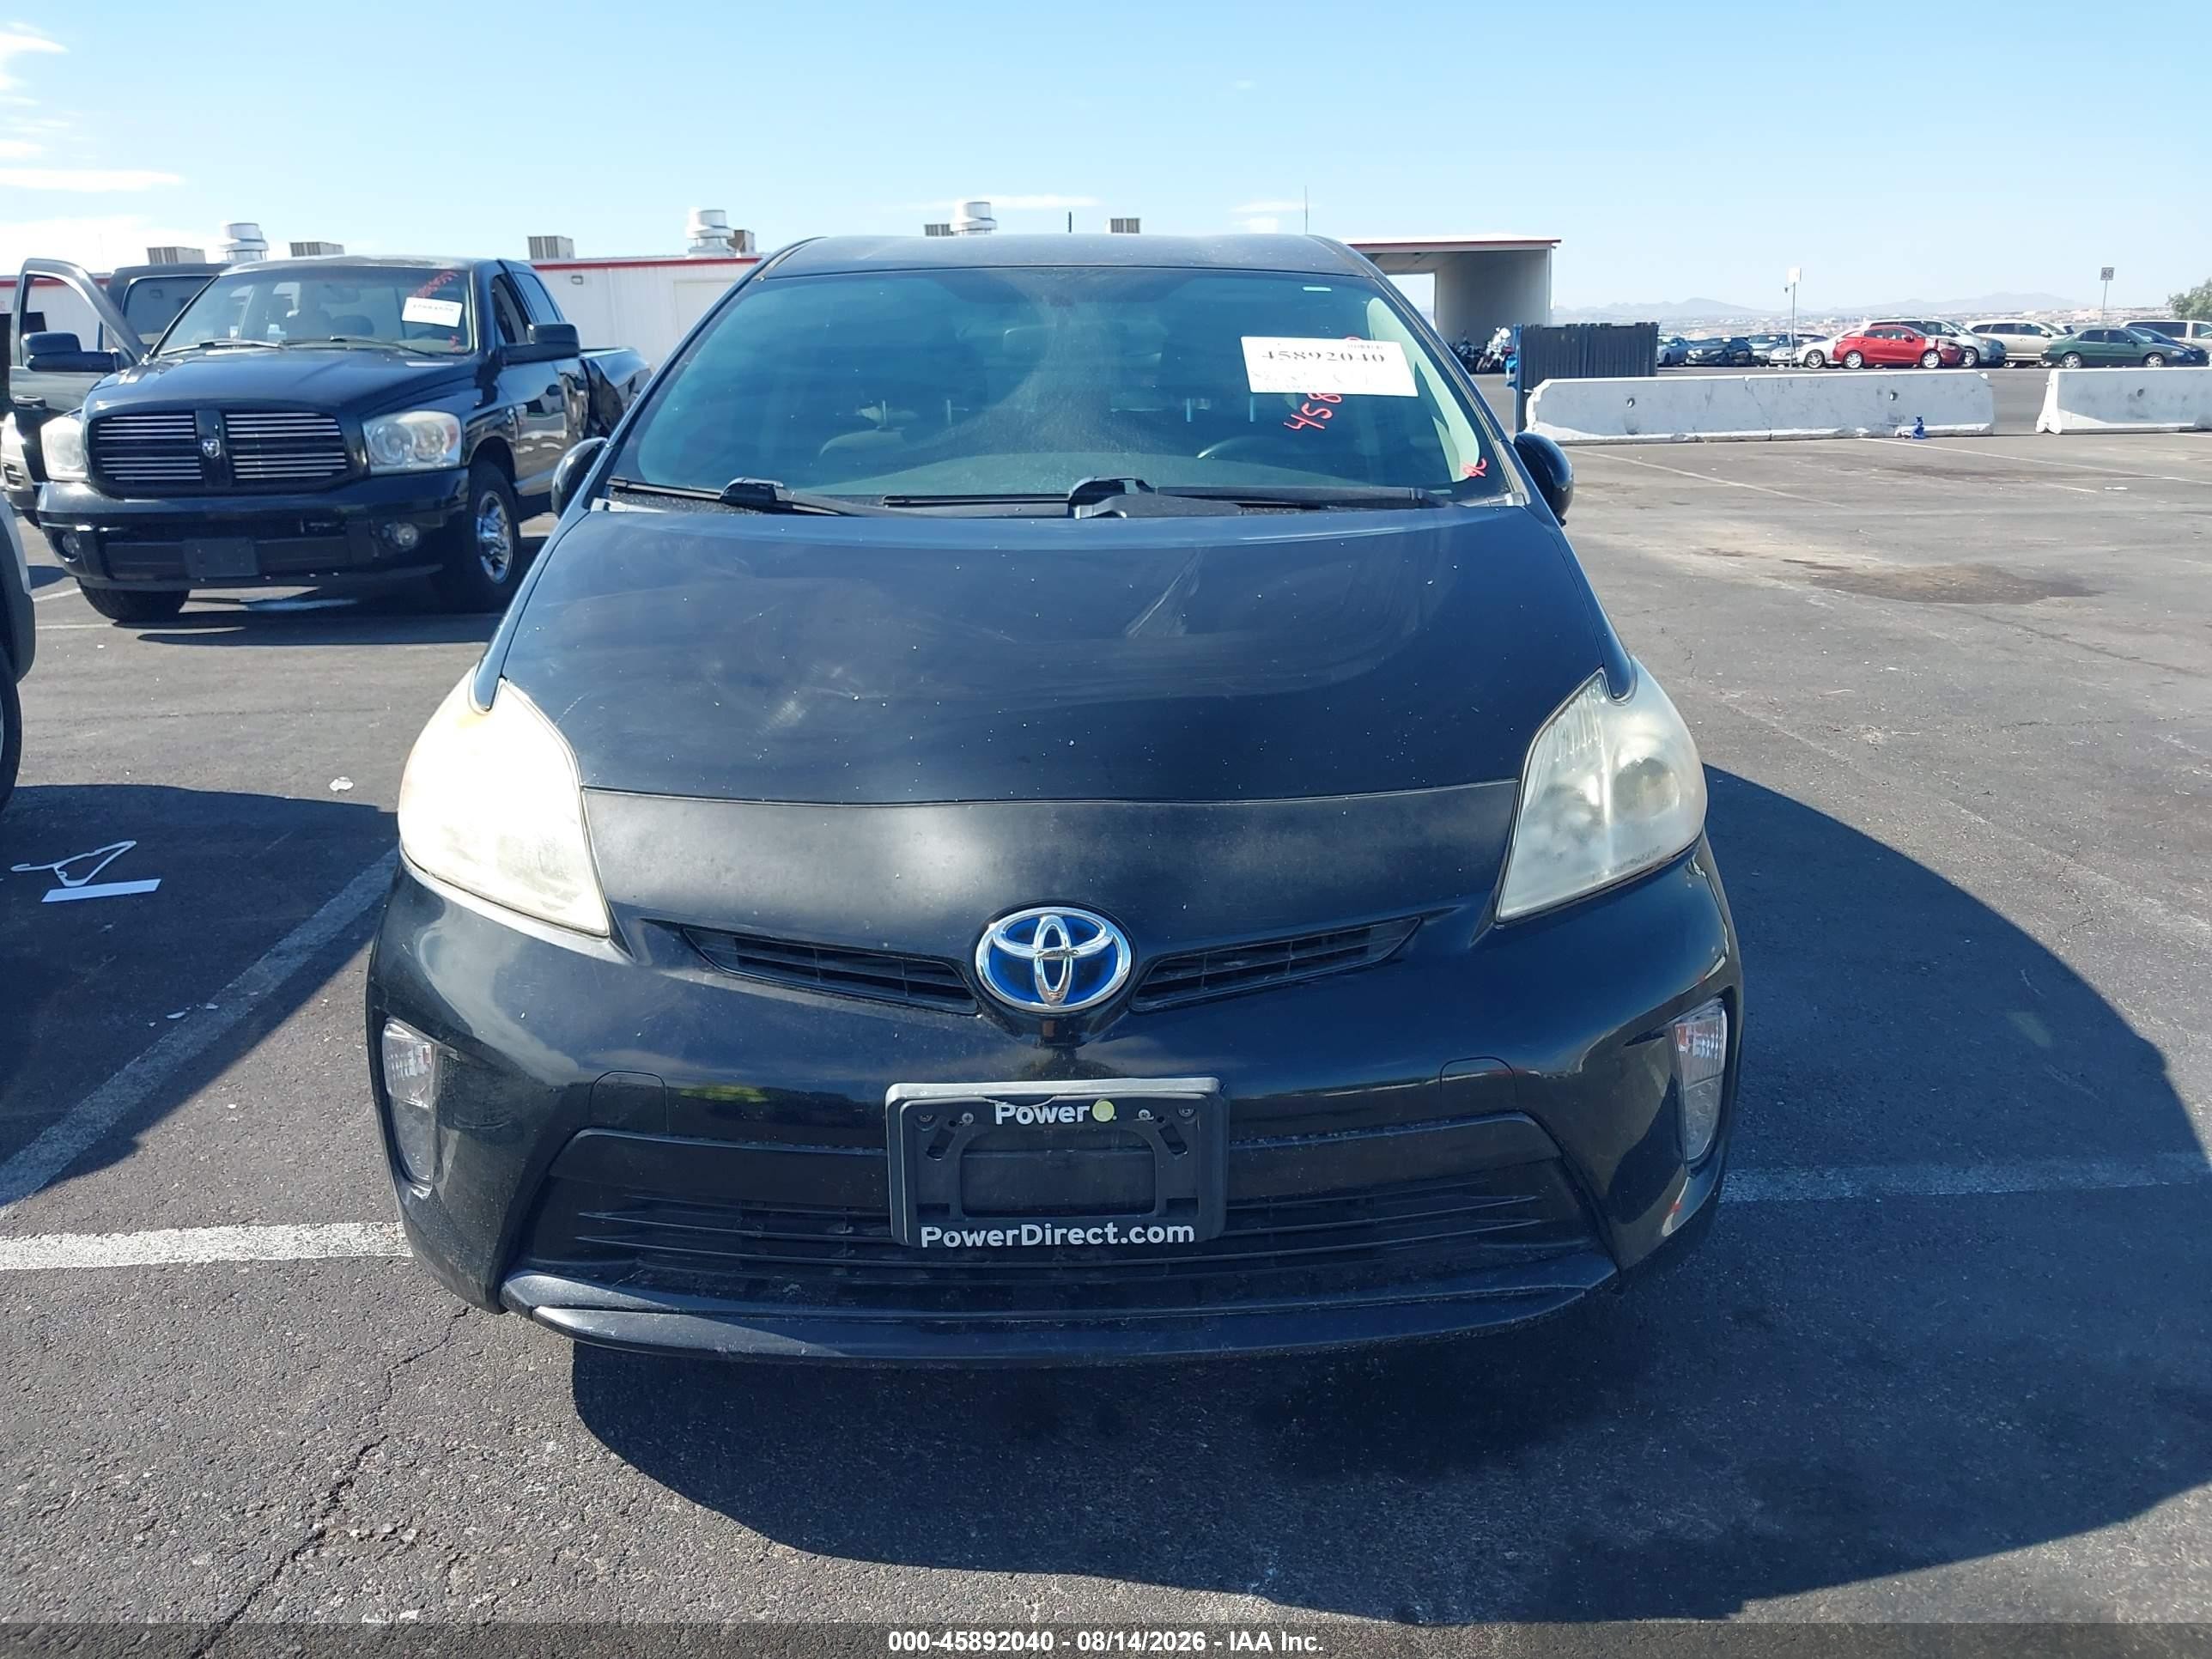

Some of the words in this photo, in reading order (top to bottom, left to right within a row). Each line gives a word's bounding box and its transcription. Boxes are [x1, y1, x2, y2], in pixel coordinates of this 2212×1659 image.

[1261, 349, 1385, 362] 45892040
[994, 1103, 1091, 1125] Power
[920, 1221, 1195, 1249] PowerDirect.com
